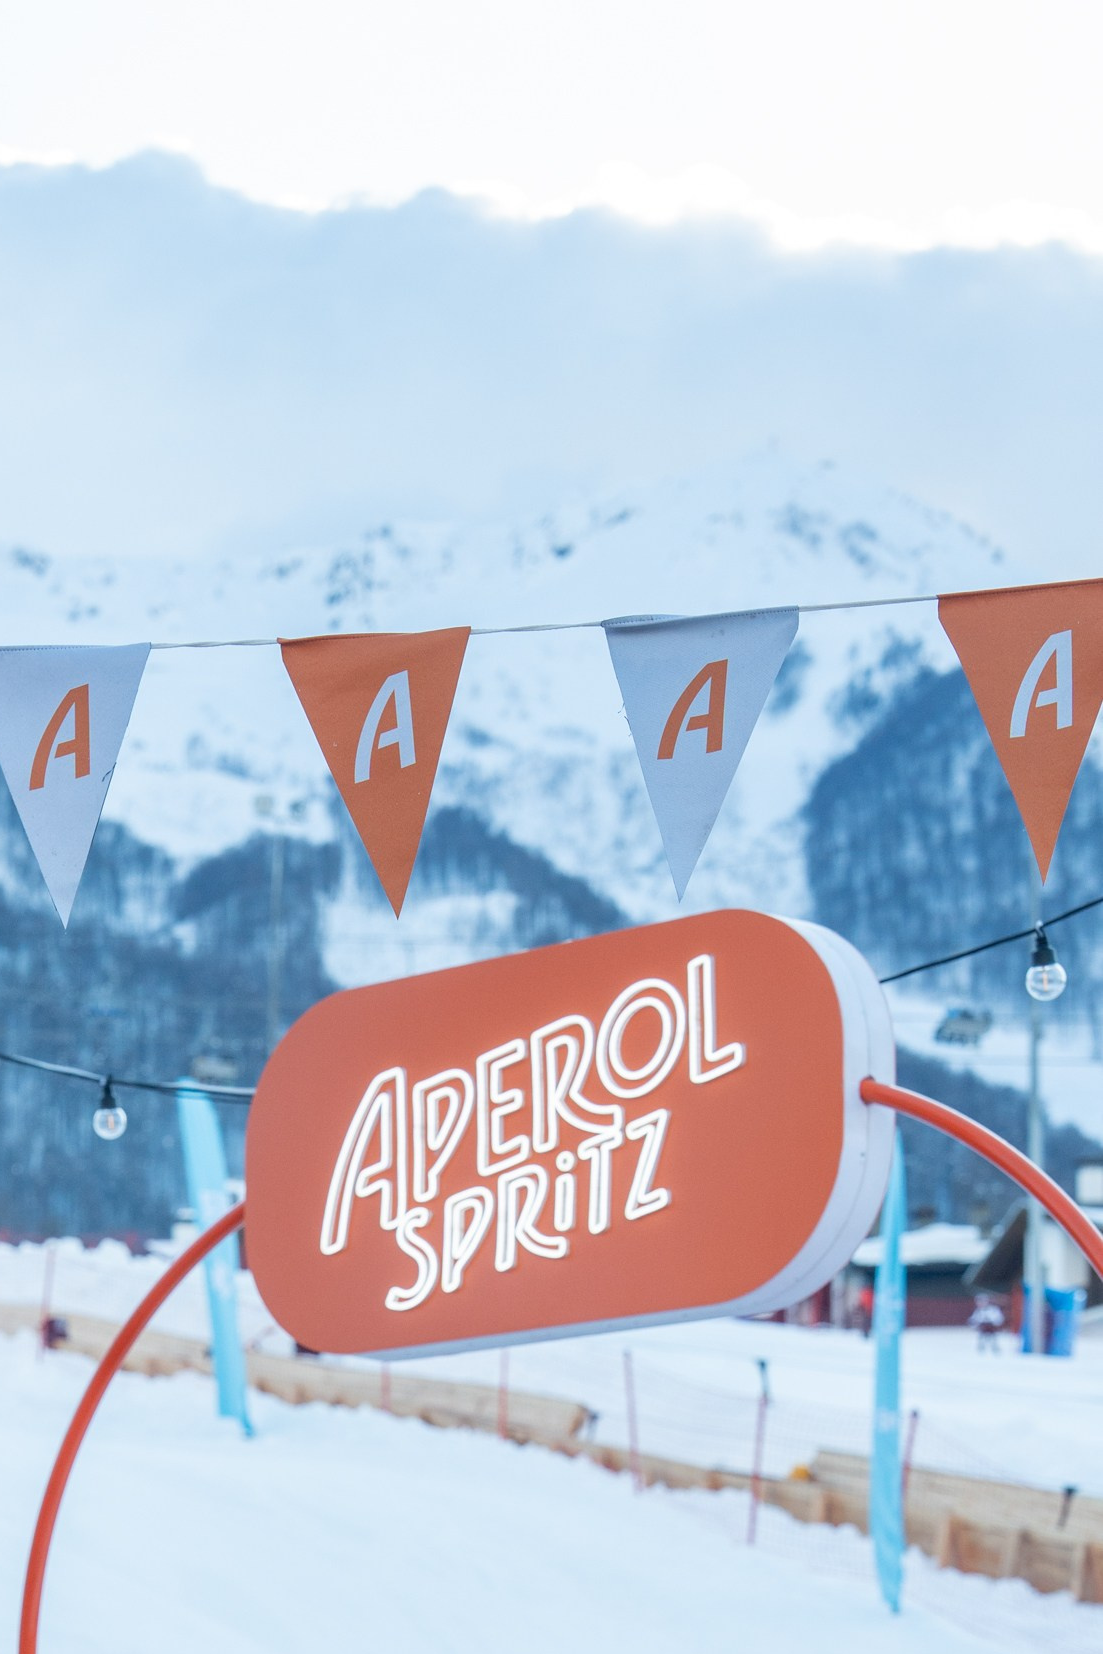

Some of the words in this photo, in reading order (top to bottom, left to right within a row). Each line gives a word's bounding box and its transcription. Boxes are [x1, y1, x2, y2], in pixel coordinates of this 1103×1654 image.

[29, 683, 91, 791] A
[354, 669, 417, 785] A
[656, 658, 729, 761] A
[1009, 629, 1074, 739] A
[319, 953, 746, 1256] APEROL
